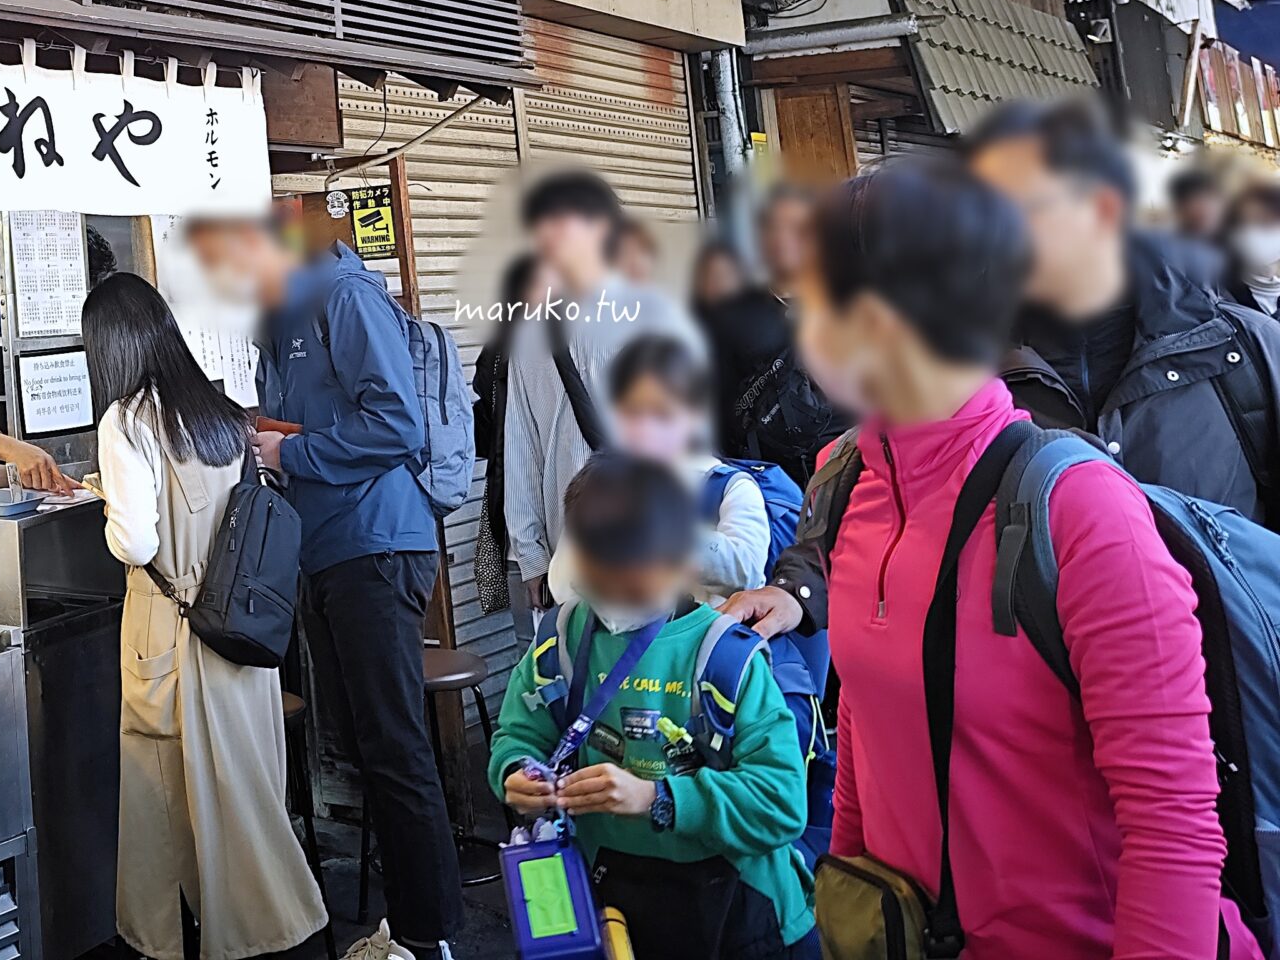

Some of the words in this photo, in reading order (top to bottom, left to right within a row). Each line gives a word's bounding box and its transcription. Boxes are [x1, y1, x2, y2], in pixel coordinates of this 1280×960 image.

[205, 107, 221, 189] ホルモン
[351, 188, 389, 200] 防犯カメラ
[360, 234, 391, 245] WARNING
[32, 377, 43, 385] food
[50, 375, 62, 383] drink
[633, 678, 661, 692] CALL
